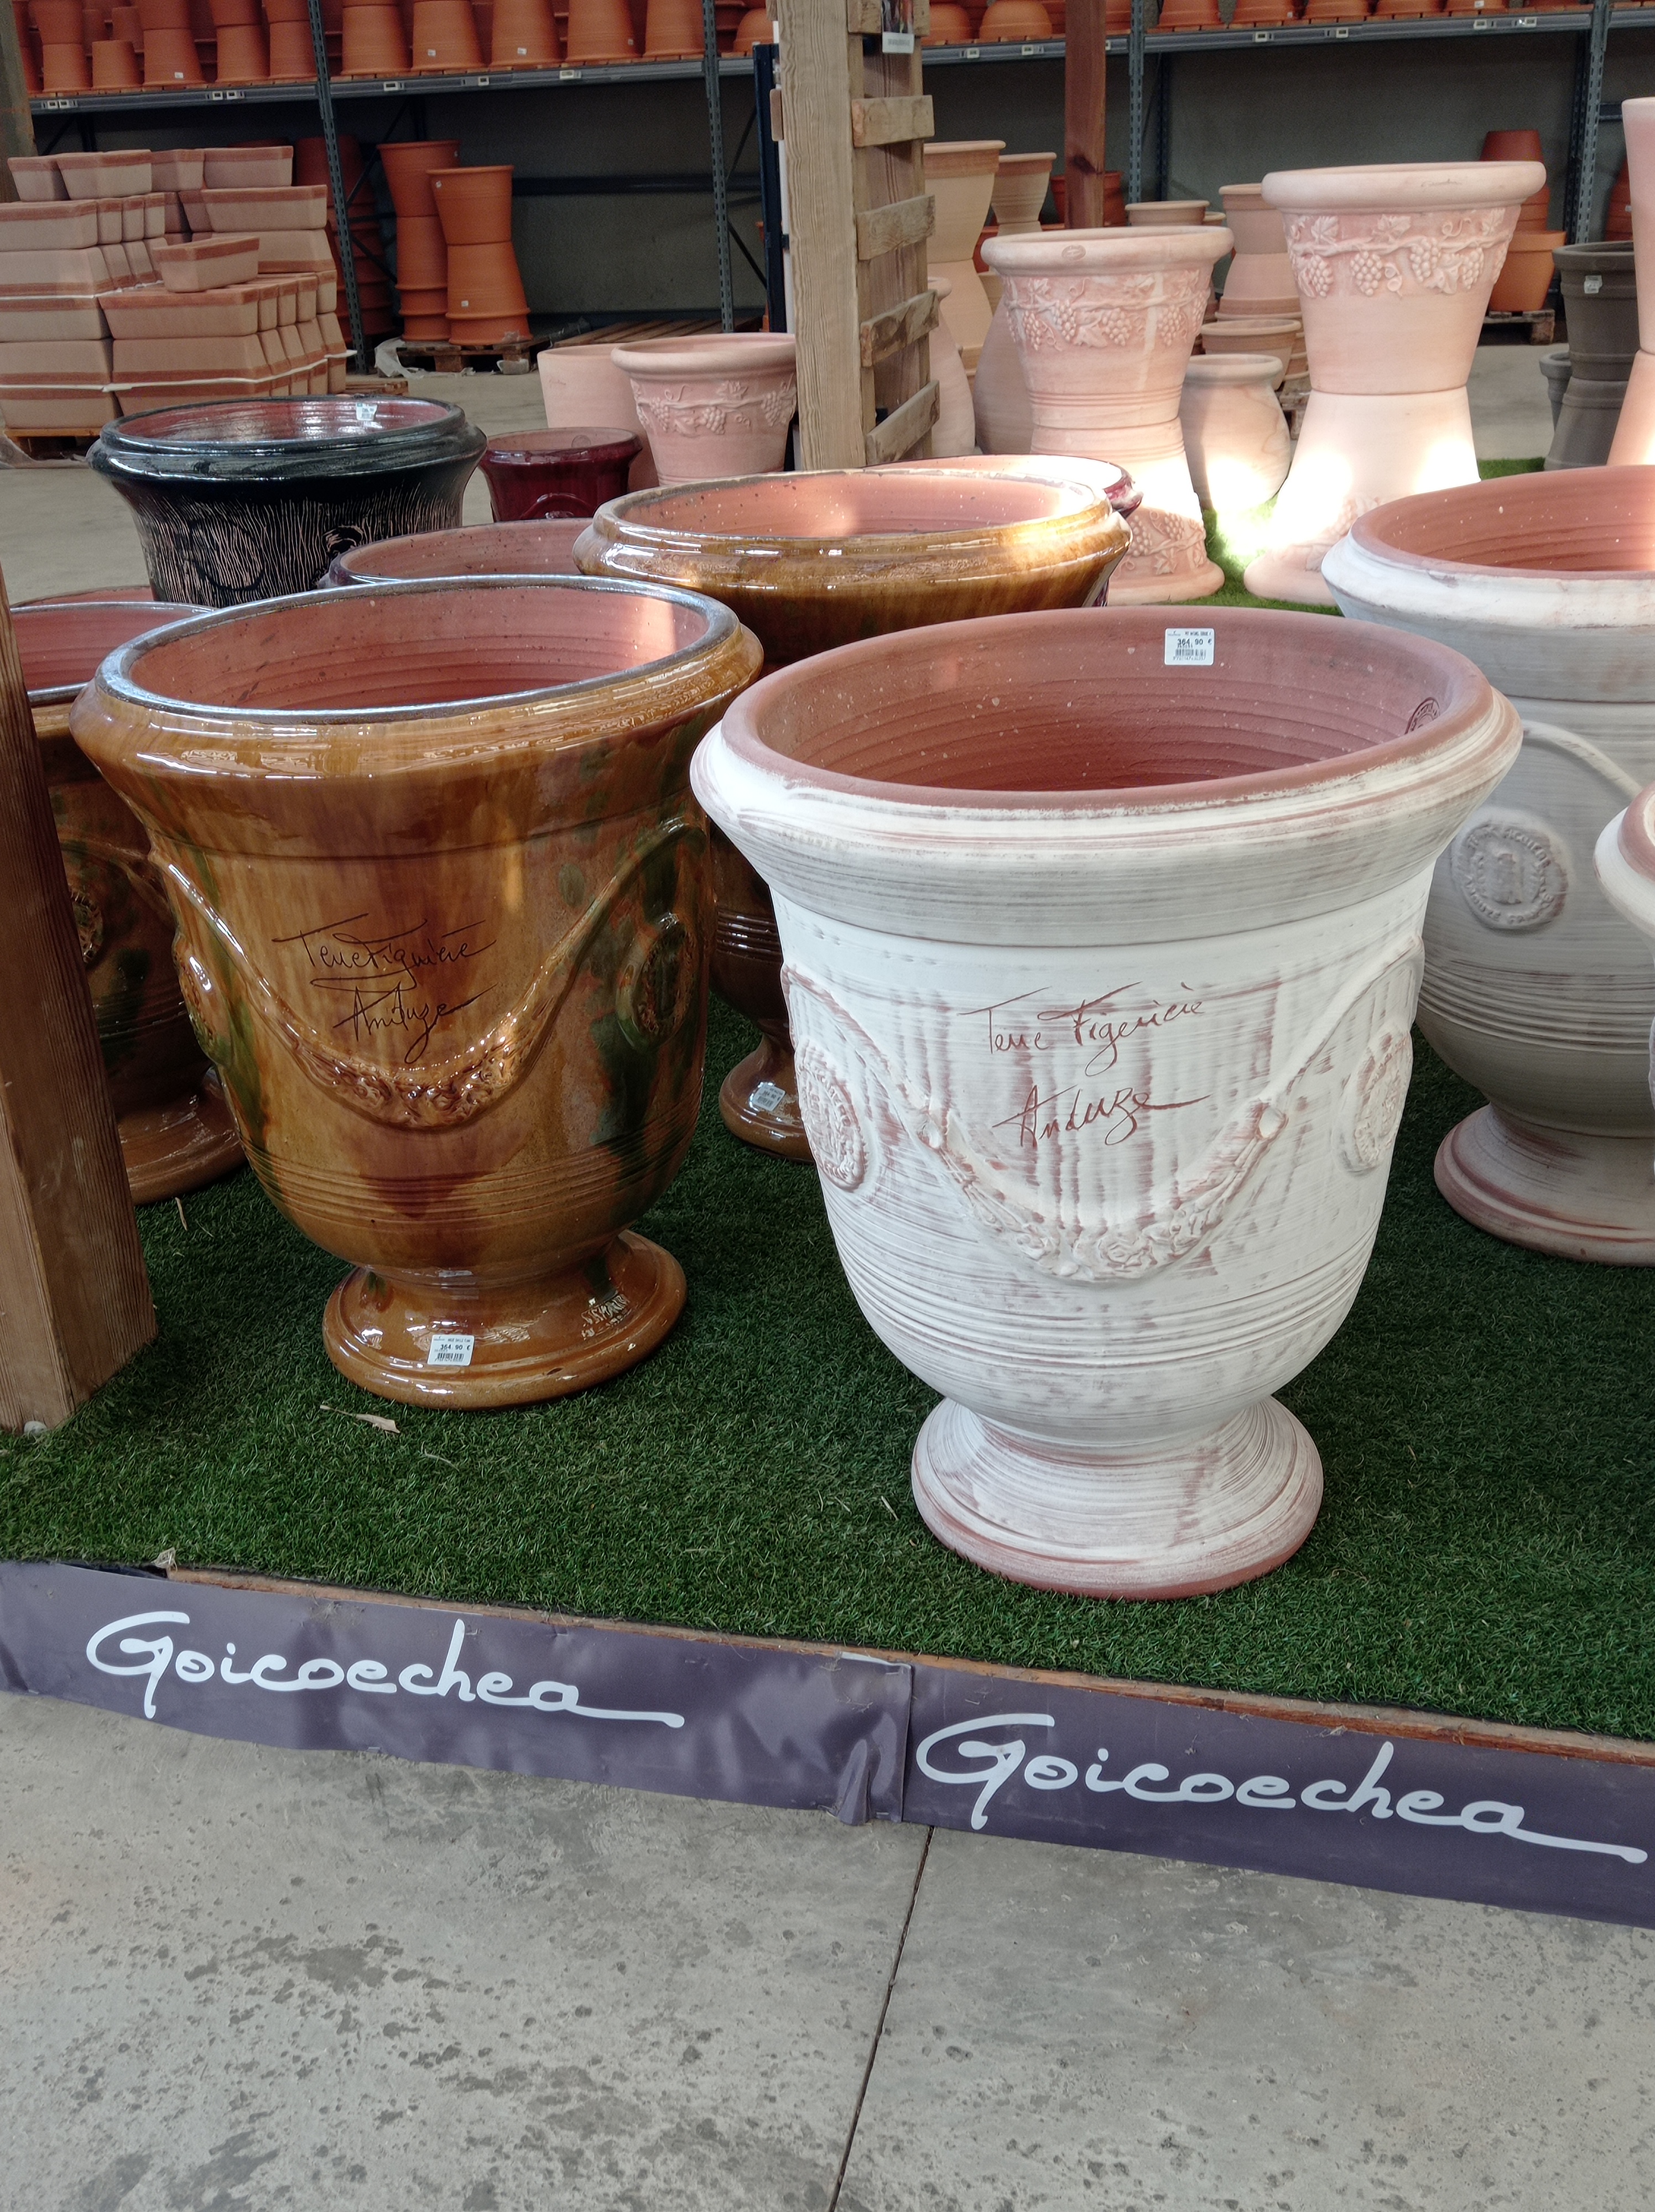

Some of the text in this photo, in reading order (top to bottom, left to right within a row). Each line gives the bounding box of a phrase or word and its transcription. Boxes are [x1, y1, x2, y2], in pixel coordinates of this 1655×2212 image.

[332, 981, 498, 1064] Anduze
[992, 1083, 1214, 1149] Anduze
[86, 1610, 685, 1728] Goicoechea
[915, 1712, 1648, 1864] Goicoechea
